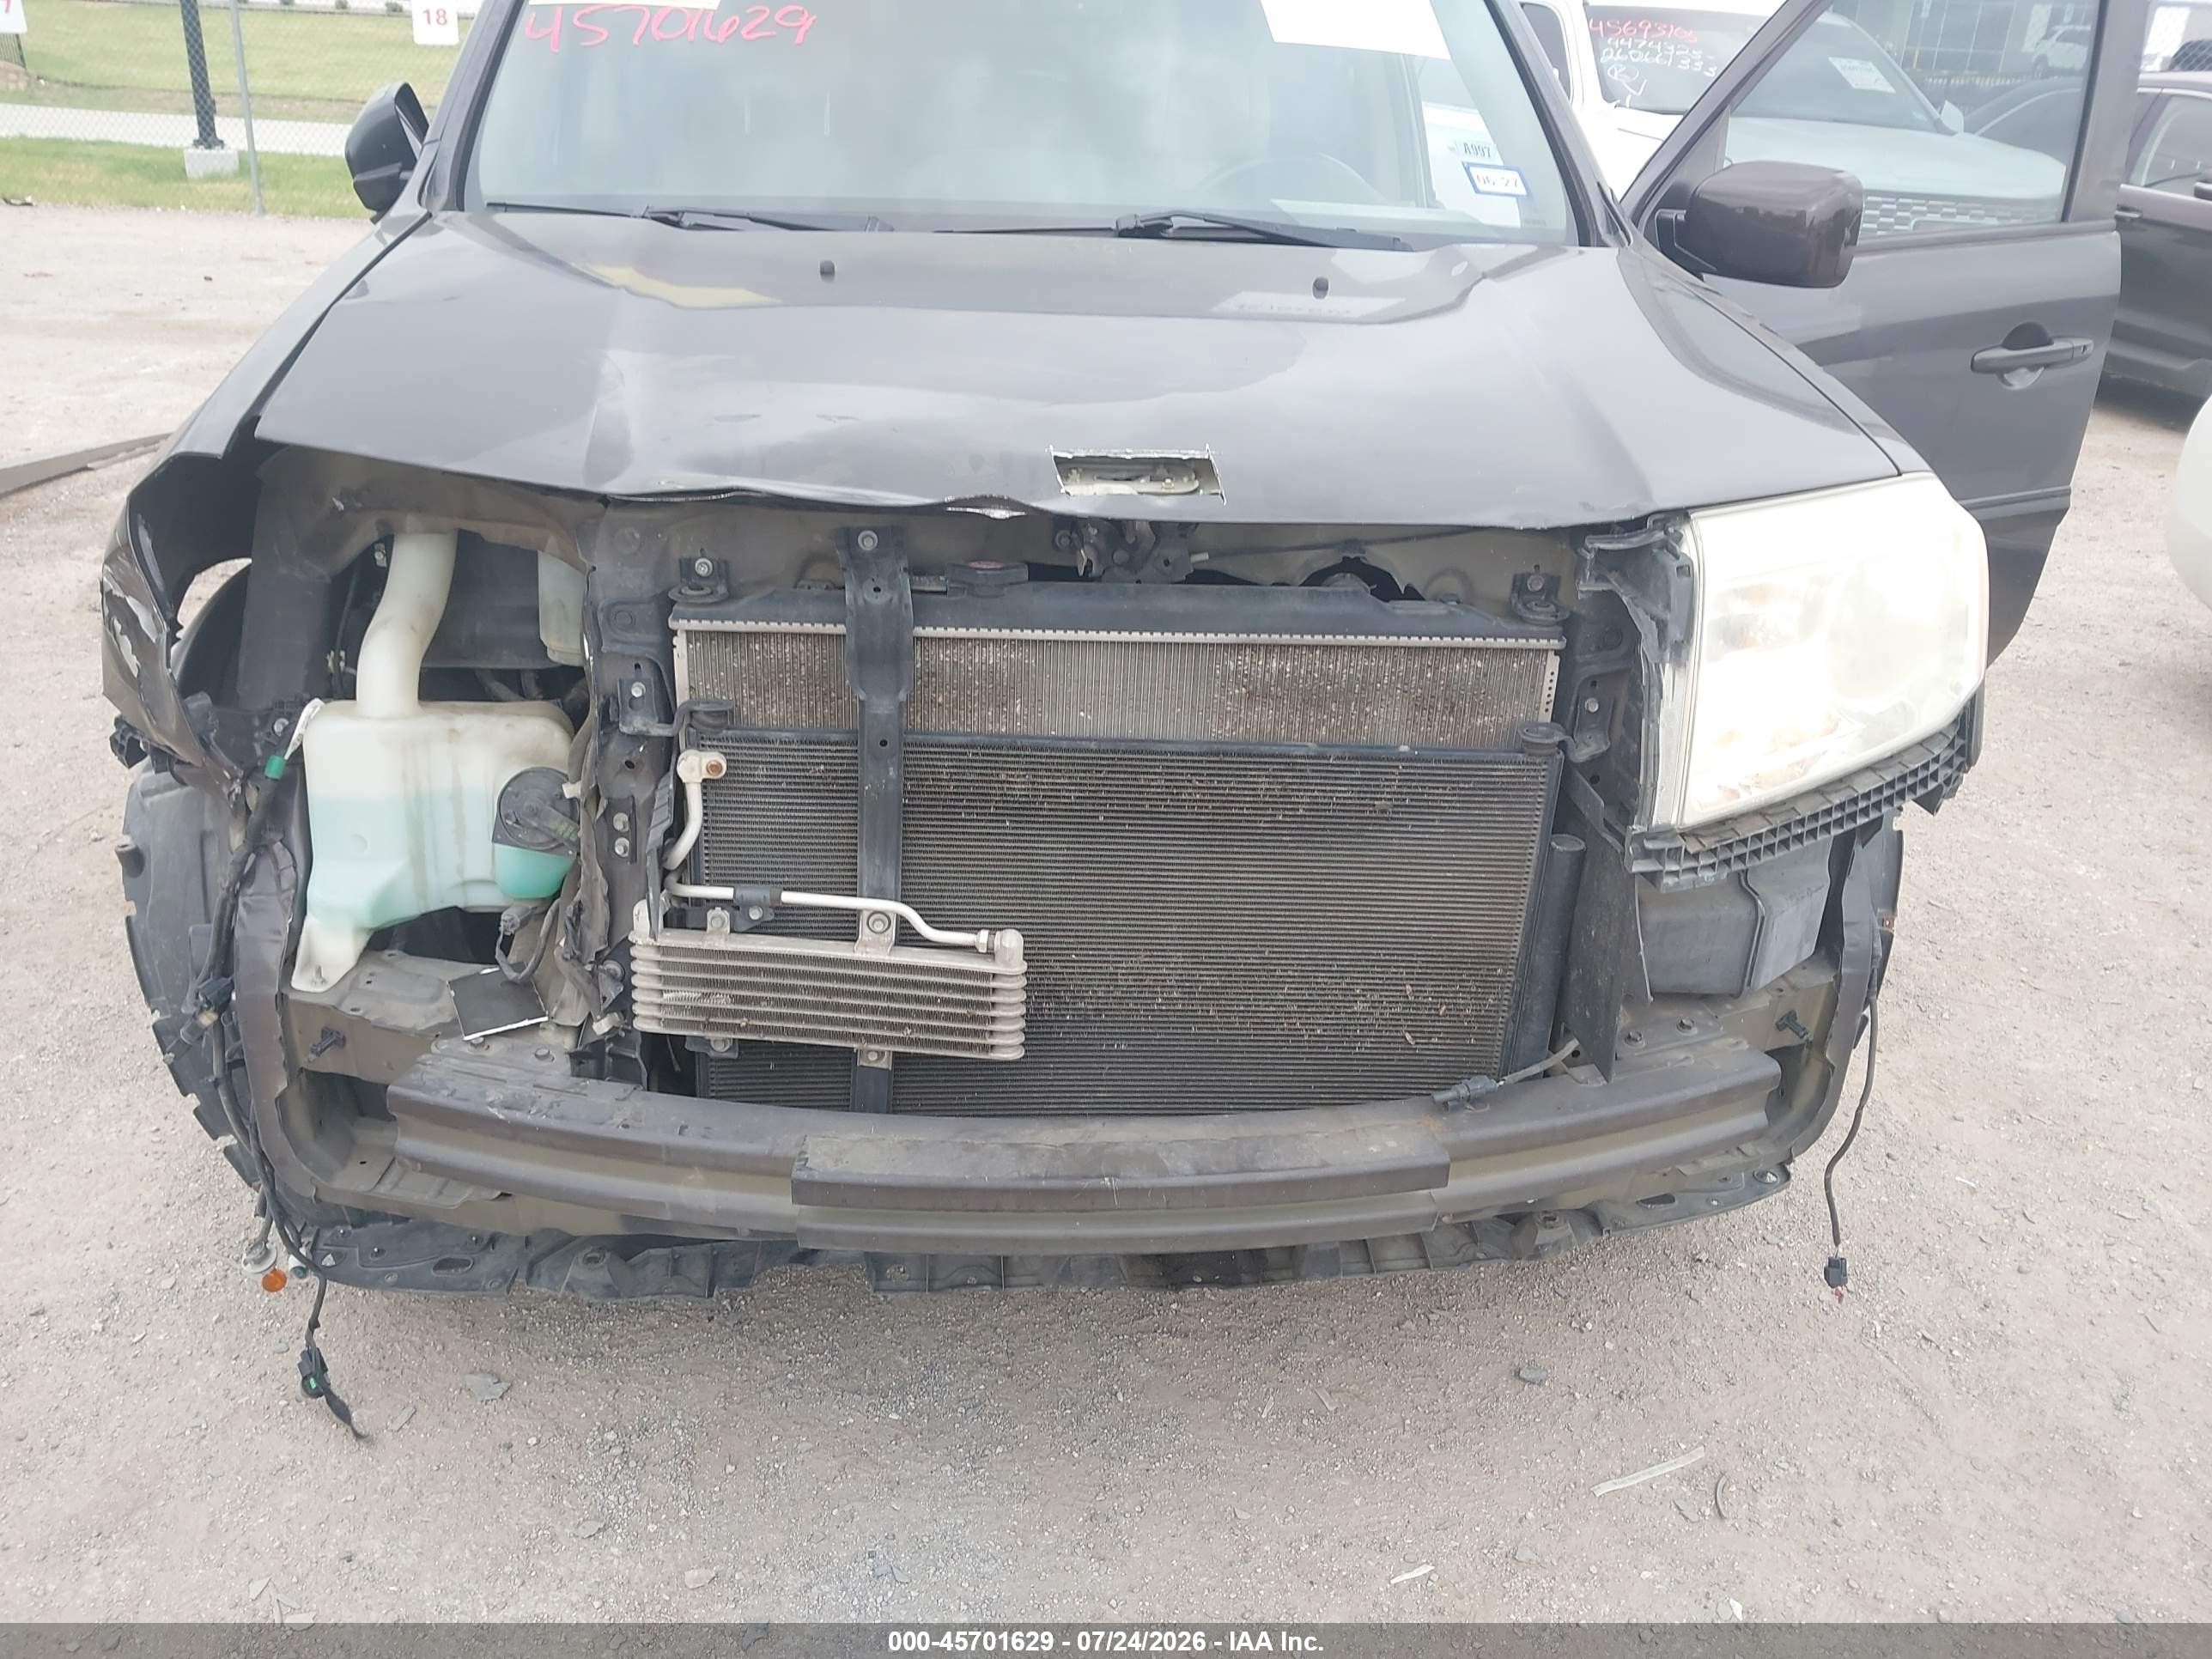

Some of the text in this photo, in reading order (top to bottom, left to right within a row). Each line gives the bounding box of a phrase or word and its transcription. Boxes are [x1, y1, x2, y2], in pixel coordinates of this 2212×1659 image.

[422, 8, 447, 26] 18
[525, 4, 817, 53] 45701629
[1463, 143, 1491, 158] A997
